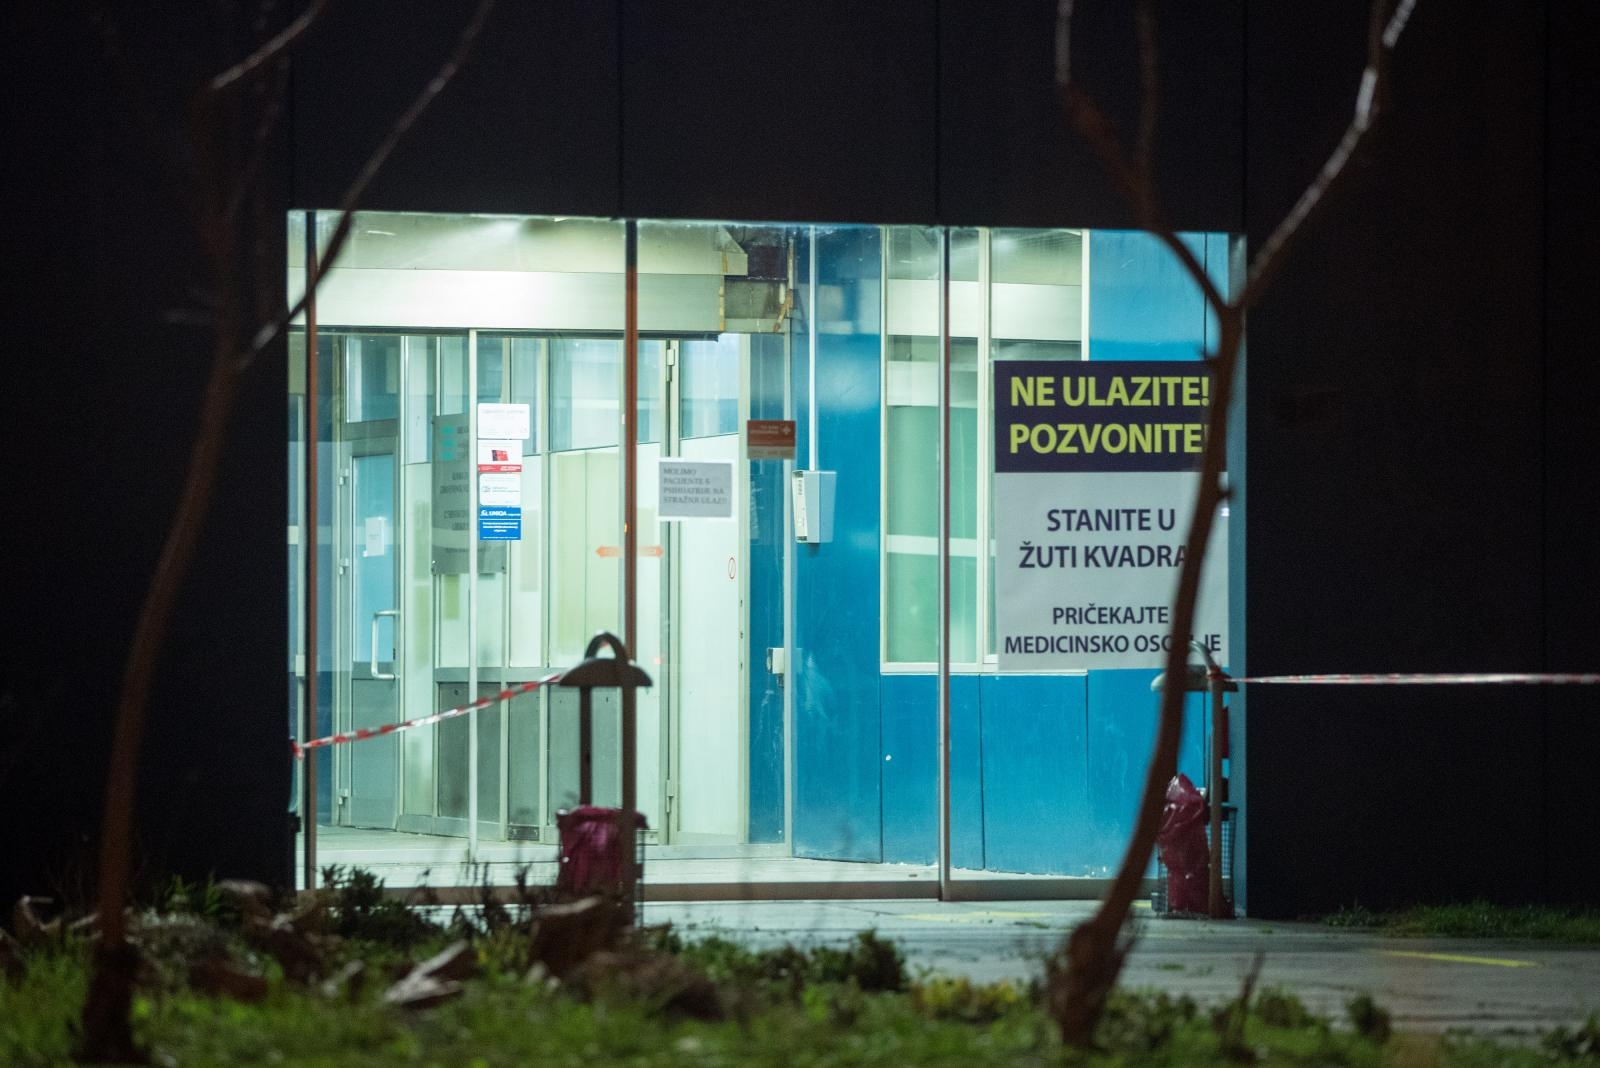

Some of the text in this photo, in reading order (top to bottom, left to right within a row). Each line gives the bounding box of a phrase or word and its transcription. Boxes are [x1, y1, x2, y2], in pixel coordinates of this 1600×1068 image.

[1010, 376, 1210, 407] NE ULAZITE!
[663, 467, 697, 475] MOLIMO
[663, 477, 704, 485] PACIJENTE
[1046, 508, 1176, 532] STANITE U
[1019, 540, 1188, 569] ŽUTI KVADRA
[1052, 602, 1169, 625] PRIČEKAJTE
[1004, 634, 1222, 654] MEDICINSKO OSOJE
